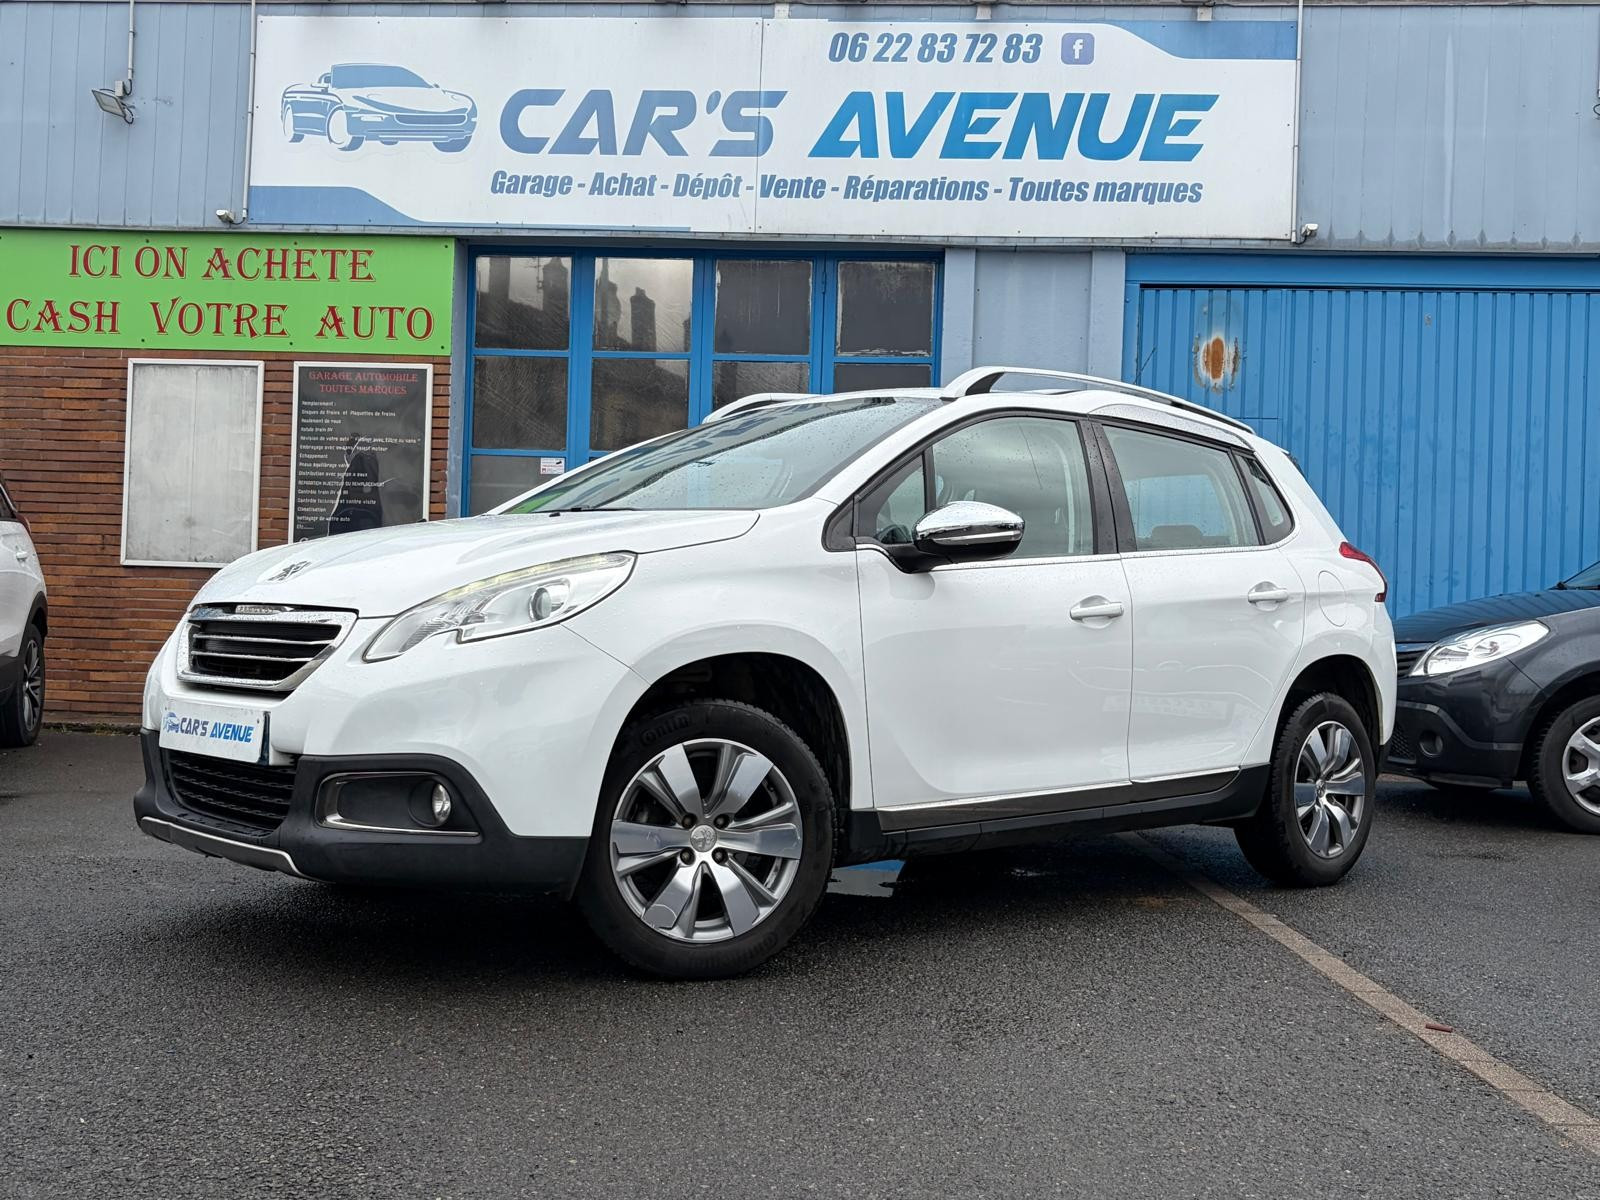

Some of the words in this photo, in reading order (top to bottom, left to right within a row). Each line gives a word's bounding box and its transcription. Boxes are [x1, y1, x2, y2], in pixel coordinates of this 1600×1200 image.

[828, 31, 870, 63] 06
[873, 31, 913, 64] 22
[917, 32, 959, 64] 83
[963, 32, 999, 64] 72
[1001, 32, 1044, 65] 83
[500, 88, 788, 158] CAR'S
[808, 90, 1220, 162] AVENUE
[491, 171, 573, 198] Garage
[590, 172, 657, 197] Achat
[673, 172, 742, 199] Dépôt
[759, 175, 827, 199] Vente
[844, 175, 989, 202] Réparations
[1009, 177, 1088, 202] Toutes
[1093, 180, 1203, 205] marques
[70, 245, 121, 278] ICI
[135, 245, 188, 279] ON
[202, 247, 376, 282] ACHETE
[6, 298, 120, 334] CASH
[151, 297, 289, 339] VOTRE
[315, 305, 435, 340] AUTO
[309, 371, 352, 381] GARAGE
[355, 372, 418, 382] AUTOMOBILE
[320, 384, 357, 393] TOUTES
[359, 384, 407, 395] MARQUES
[180, 717, 209, 737] CAR'S
[209, 722, 254, 743] AVENUE
